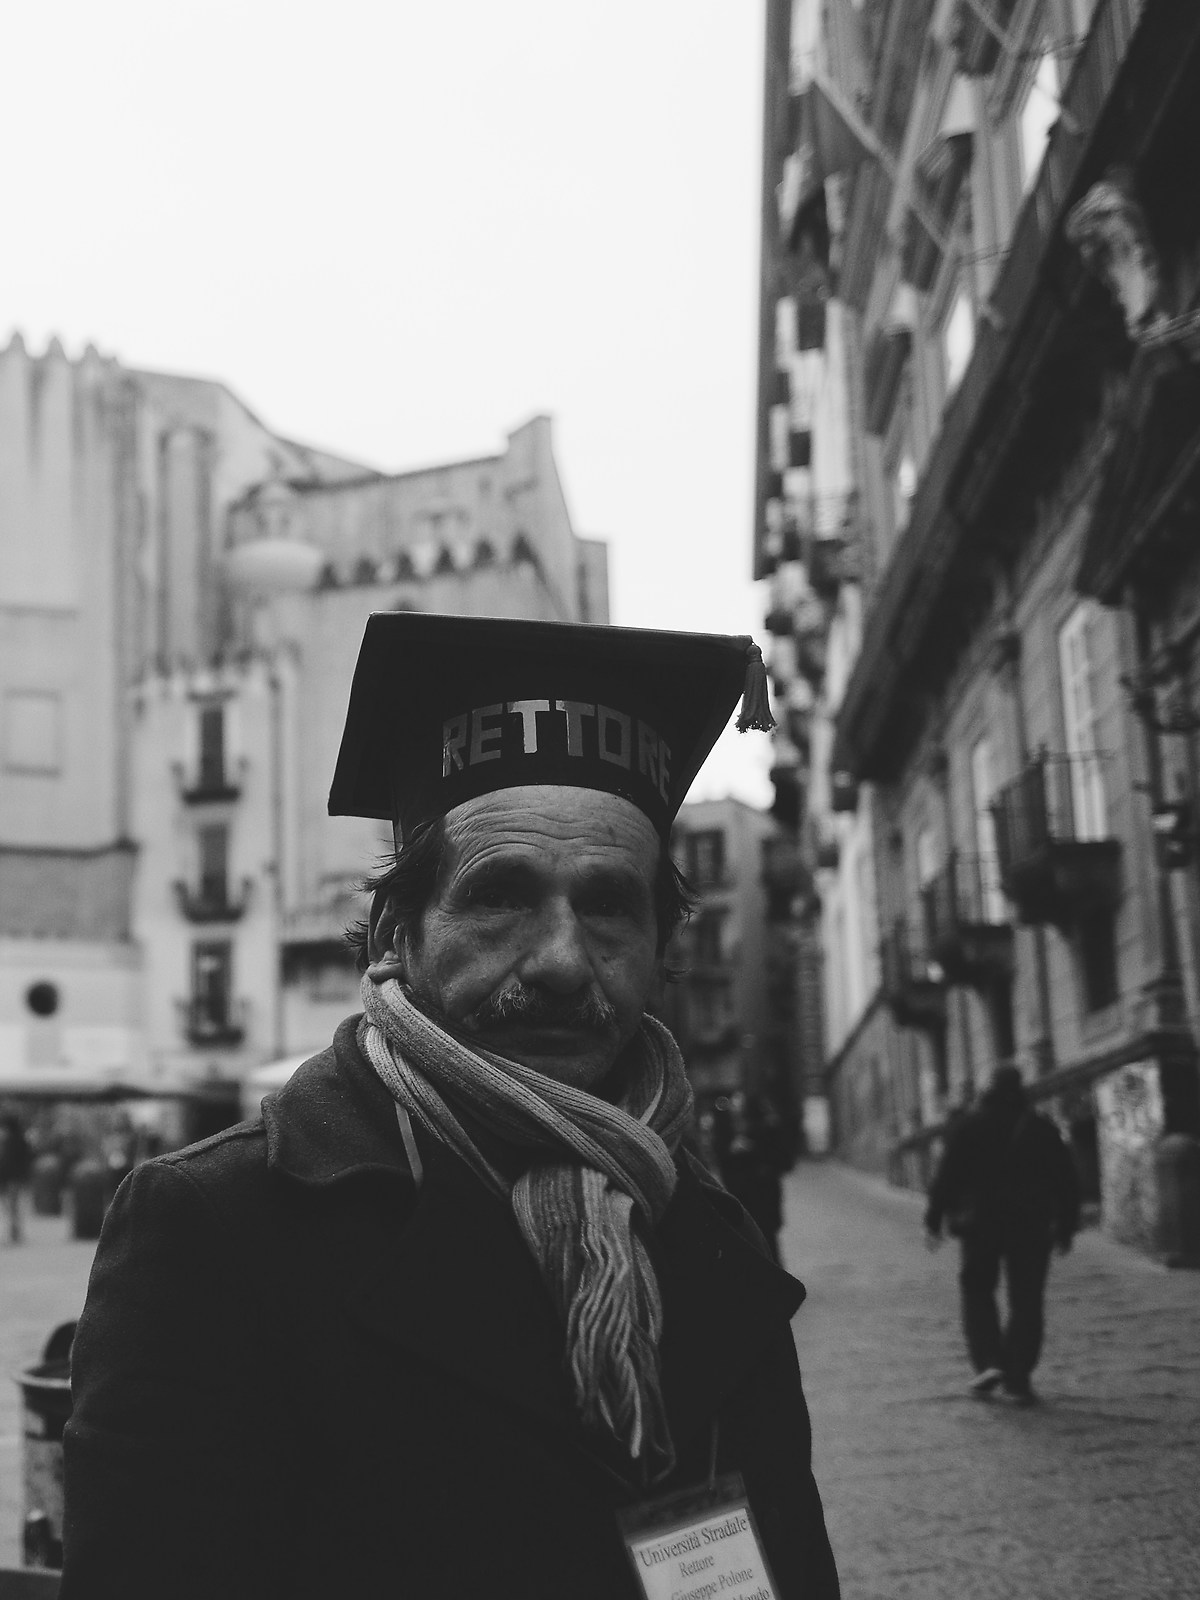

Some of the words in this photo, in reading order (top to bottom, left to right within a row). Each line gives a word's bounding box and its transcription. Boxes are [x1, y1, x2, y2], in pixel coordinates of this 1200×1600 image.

[442, 699, 671, 806] RETTORE
[639, 1531, 701, 1567] Università
[701, 1517, 747, 1545] Stradale
[679, 1555, 715, 1577] Rettore
[718, 1568, 753, 1590] Polone
